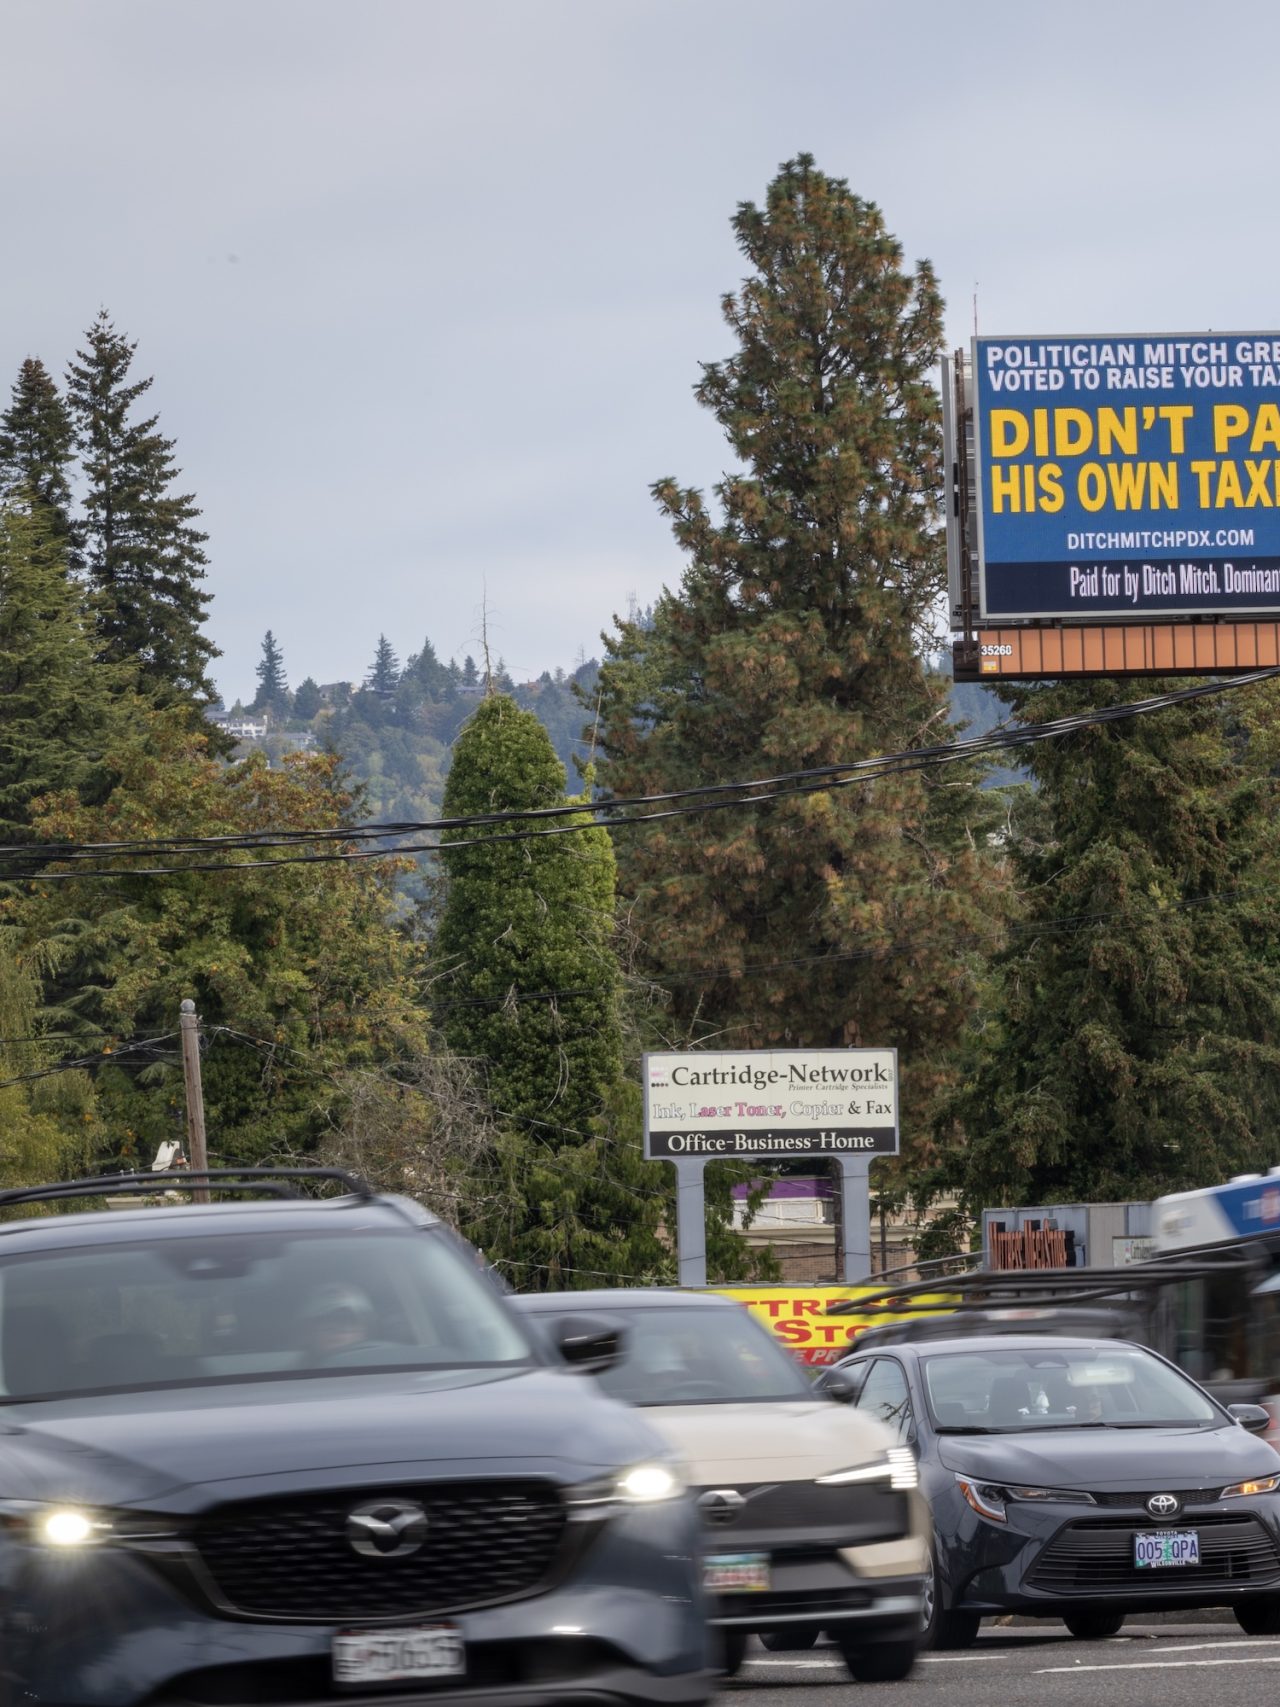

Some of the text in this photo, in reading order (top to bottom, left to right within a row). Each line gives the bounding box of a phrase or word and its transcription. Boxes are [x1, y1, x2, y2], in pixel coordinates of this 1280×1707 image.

[987, 344, 1135, 368] POLITICIAN
[1144, 343, 1227, 364] MITCH
[988, 369, 1065, 392] VOTED
[1073, 368, 1101, 390] TO
[1106, 366, 1175, 389] RAISE
[1180, 365, 1244, 388] YOUR
[990, 405, 1194, 458] DIDN’T
[991, 462, 1065, 514] HIS
[1077, 460, 1179, 512] OWN
[1067, 529, 1254, 550] DITCHMITCHPDX.COM
[1070, 566, 1098, 597] Paid
[1102, 566, 1121, 597] for
[1124, 565, 1139, 603] by
[1143, 564, 1176, 595] Ditch
[1179, 563, 1221, 595] Mitch.
[671, 1062, 888, 1091] Cartridge-Network
[815, 1082, 849, 1091] Cartridge
[851, 1081, 888, 1091] Specialists
[653, 1100, 892, 1121] Ink, Laser Toner, Copier & Fax
[667, 1132, 875, 1152] Office-Business-Home
[1137, 1540, 1198, 1560] 005 QPA
